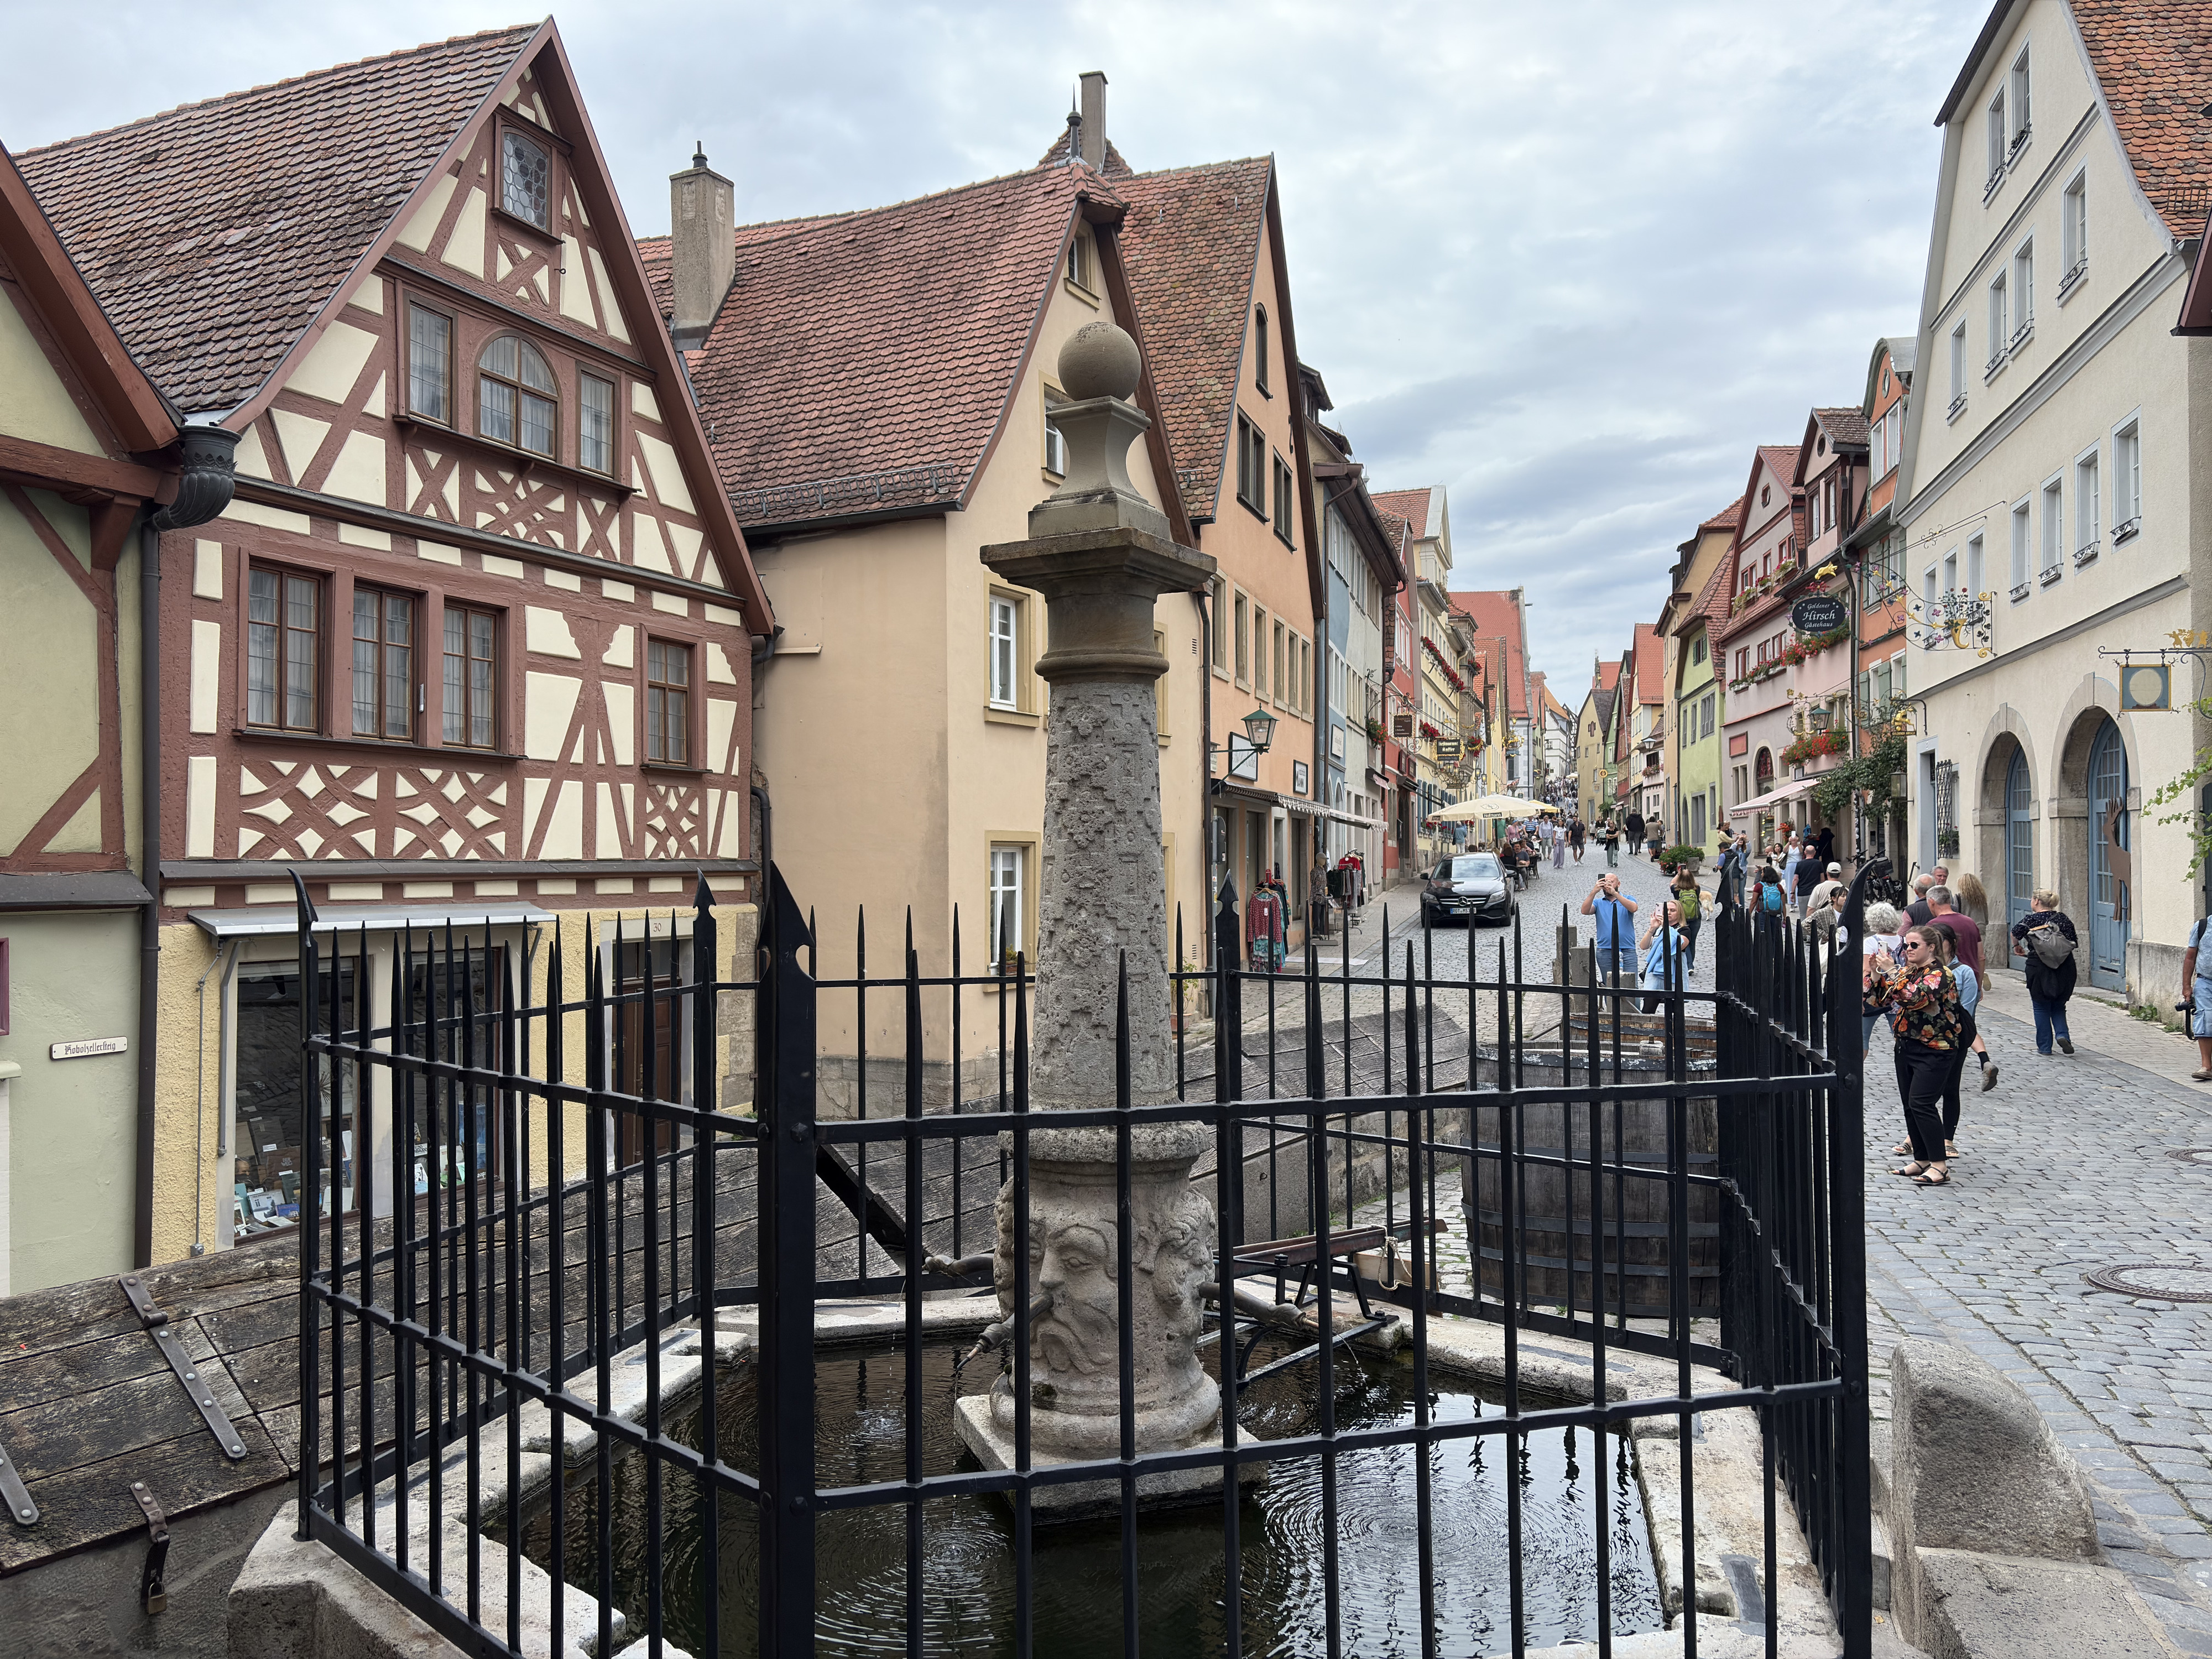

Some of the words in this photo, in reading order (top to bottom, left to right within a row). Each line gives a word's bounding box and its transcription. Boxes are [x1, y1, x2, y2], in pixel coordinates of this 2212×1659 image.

[1802, 609, 1836, 620] Hirsch
[653, 922, 662, 932] 30
[65, 1041, 116, 1055] Kobolzellersteig
